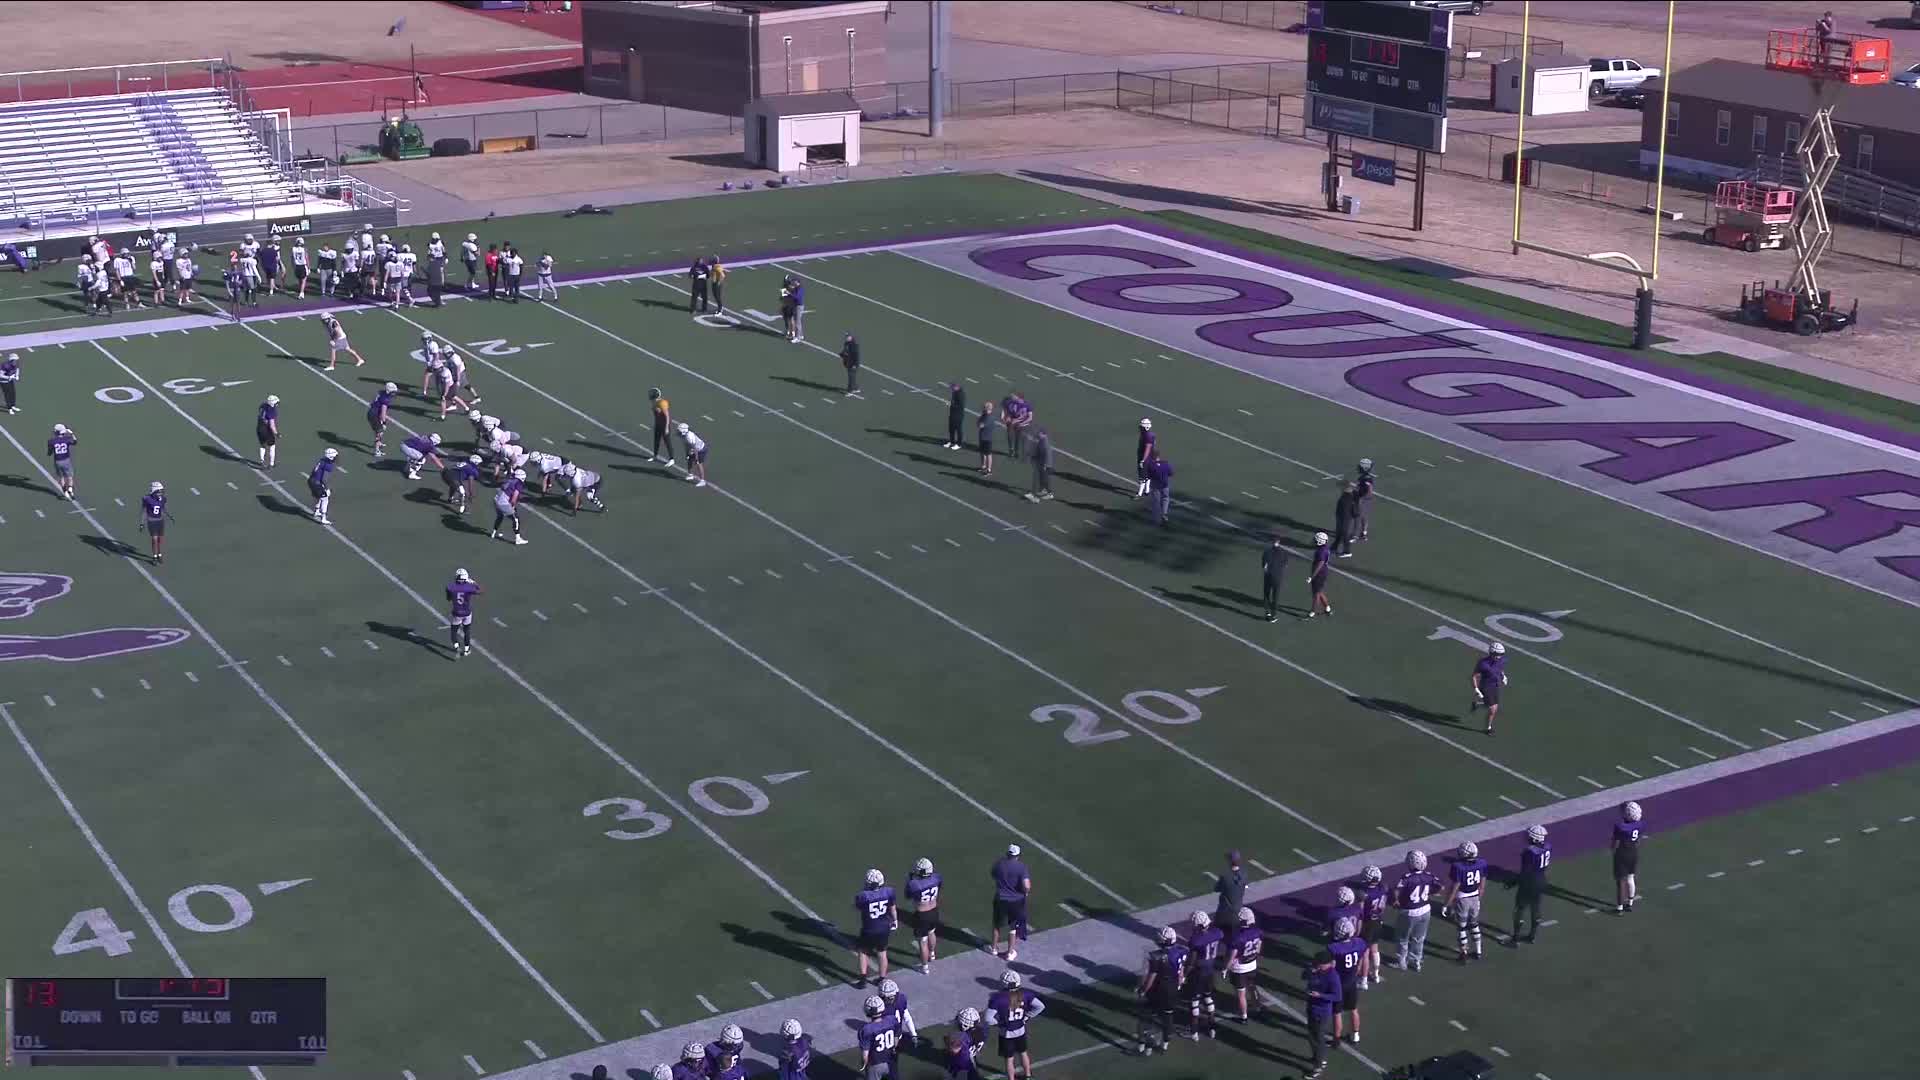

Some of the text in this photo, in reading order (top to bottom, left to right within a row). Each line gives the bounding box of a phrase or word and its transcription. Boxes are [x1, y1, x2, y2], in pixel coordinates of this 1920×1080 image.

[1366, 163, 1393, 178] pepsi
[270, 223, 301, 234] Avera
[968, 245, 1920, 582] COUGAR
[54, 443, 67, 454] 22
[456, 592, 465, 605] 5
[1631, 829, 1639, 842] 9
[1539, 850, 1552, 869] 12
[1466, 870, 1481, 886] 24
[1410, 885, 1430, 903] 44
[869, 900, 888, 920] 55
[1243, 938, 1261, 957] 23
[1345, 951, 1359, 969] 91
[875, 1030, 895, 1052] 30
